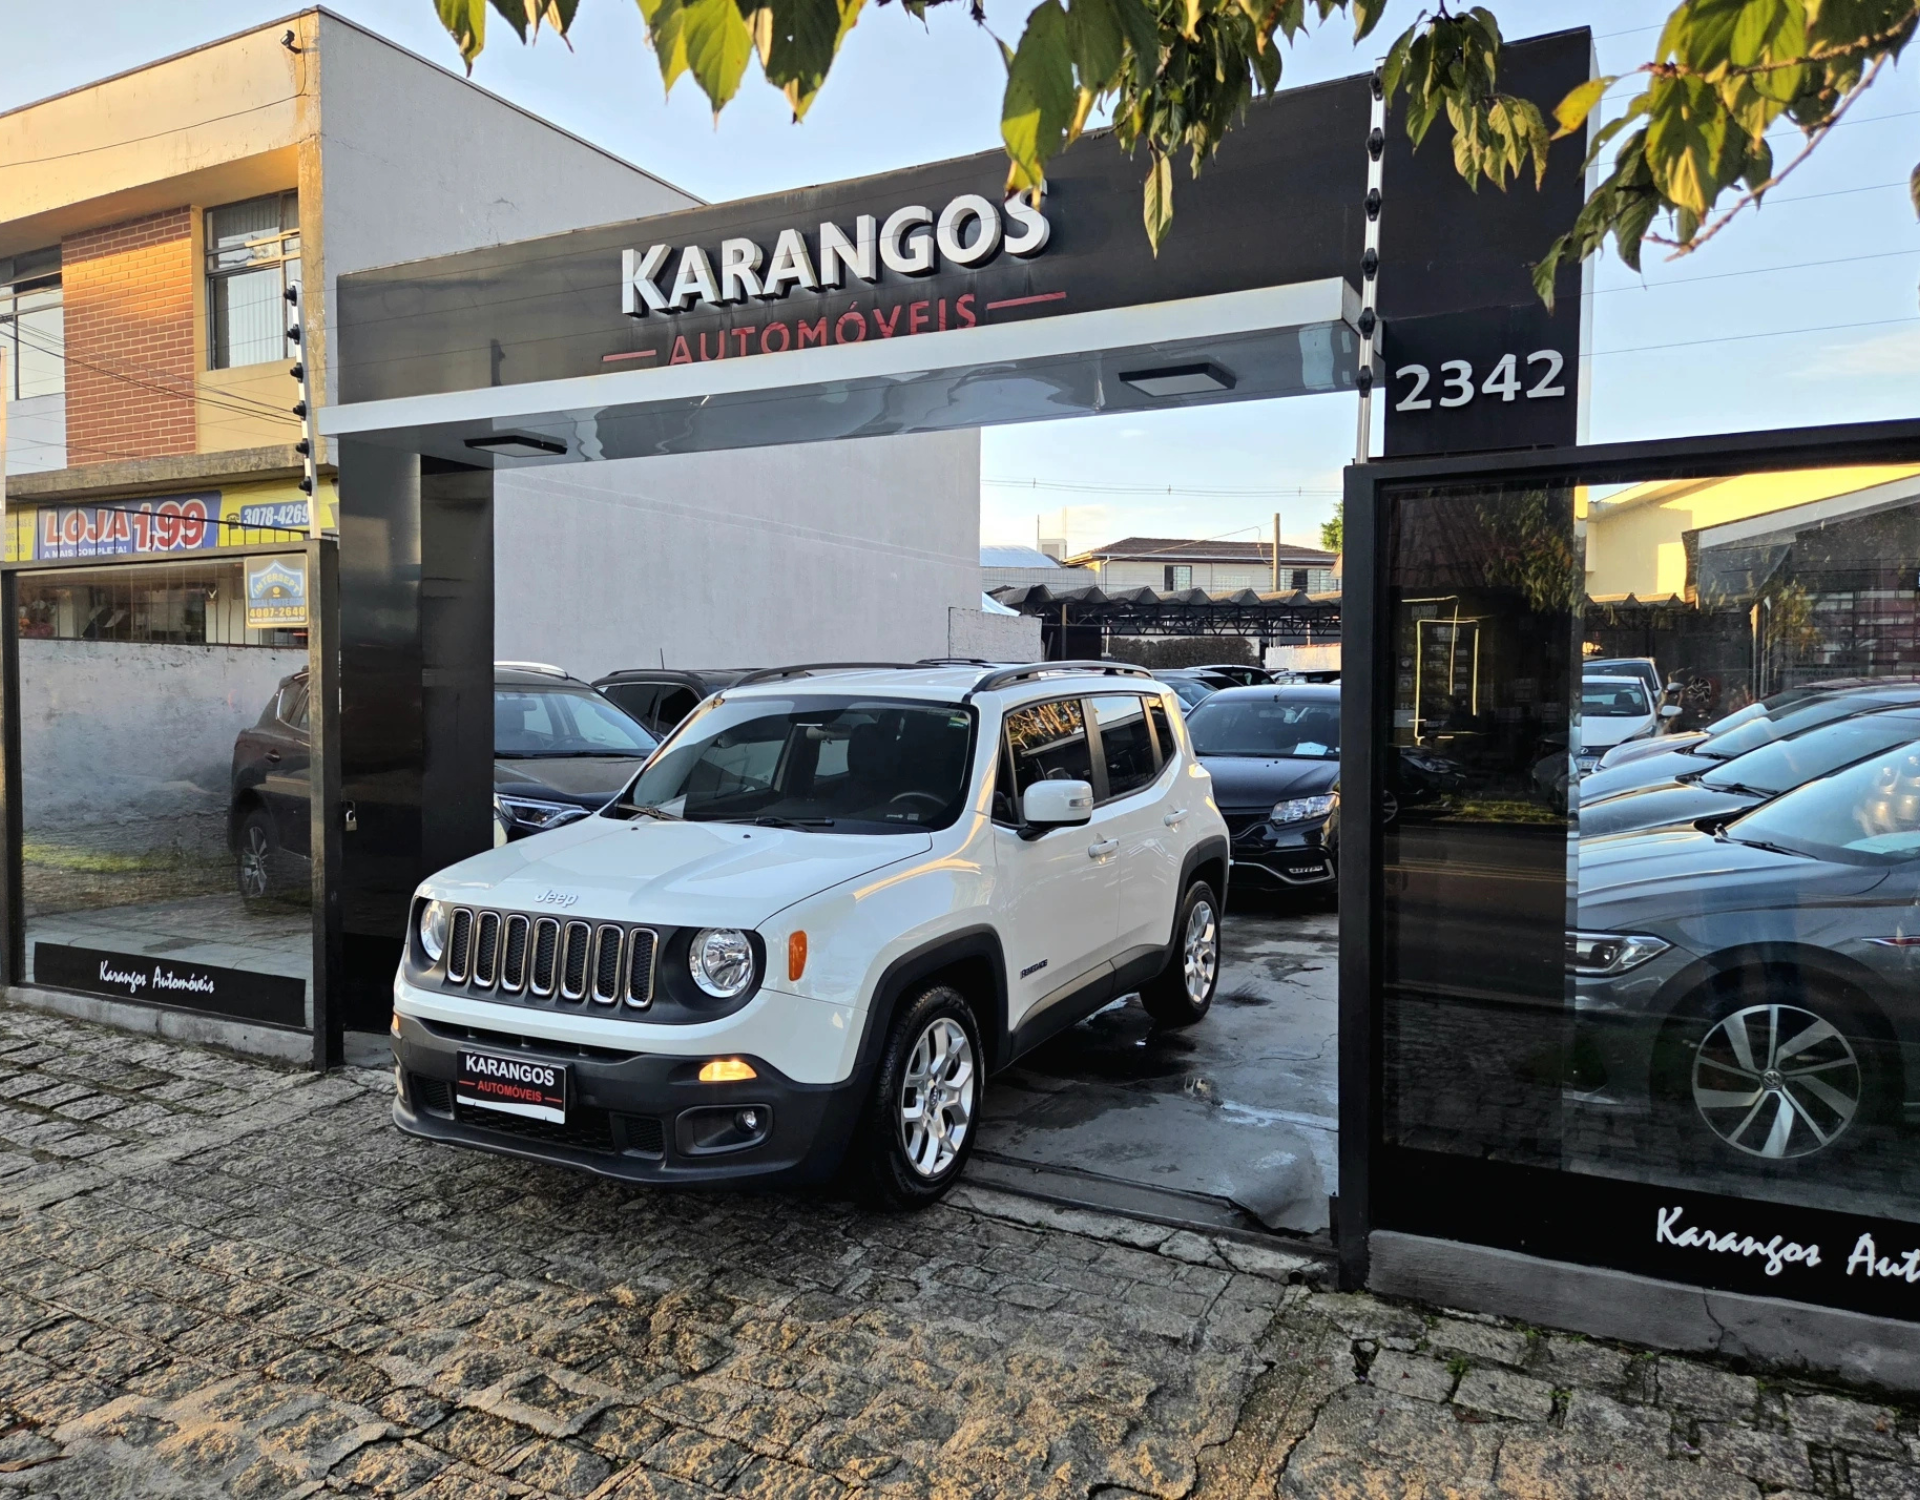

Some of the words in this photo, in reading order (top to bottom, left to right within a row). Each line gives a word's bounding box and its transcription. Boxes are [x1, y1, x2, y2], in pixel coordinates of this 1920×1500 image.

[621, 177, 1051, 317] KARANGOS
[669, 293, 977, 366] AUTOMÓVEIS
[1395, 349, 1566, 412] 2342
[44, 506, 131, 546] LOJA
[133, 499, 208, 551] 1,99
[243, 503, 310, 526] 3078-4269
[253, 572, 300, 595] INTERSEPT
[249, 606, 306, 618] 4007-2640
[534, 889, 579, 908] Jeep
[100, 959, 147, 994] Karangos
[152, 965, 215, 995] Automóveis
[465, 1054, 555, 1087] KARANGOS
[477, 1080, 542, 1103] AUTOMÓVEIS
[1656, 1206, 1822, 1276] Karangos
